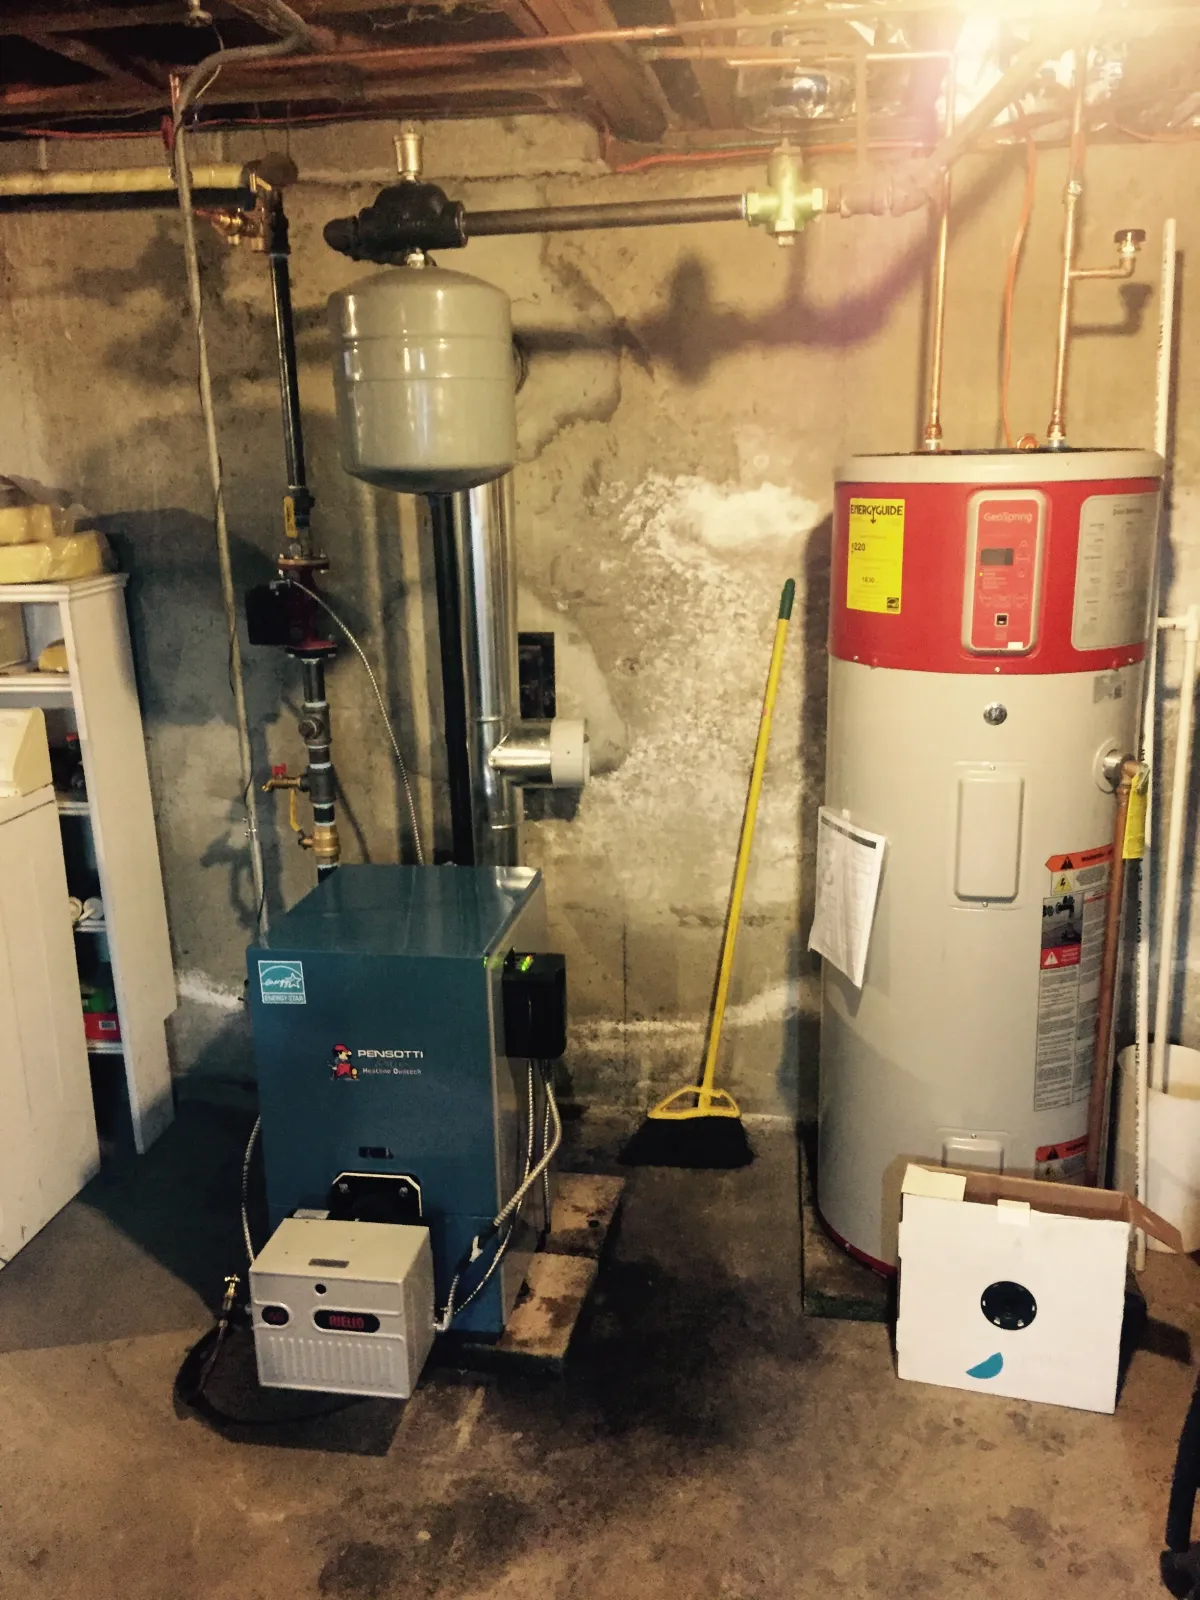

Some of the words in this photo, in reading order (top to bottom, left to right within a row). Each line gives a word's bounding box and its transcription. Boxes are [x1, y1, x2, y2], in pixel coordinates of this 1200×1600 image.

[984, 512, 1033, 524] GeoSpring
[264, 994, 287, 1002] ENERGY
[288, 994, 304, 1002] STAR
[357, 1049, 424, 1059] PENSOTTI
